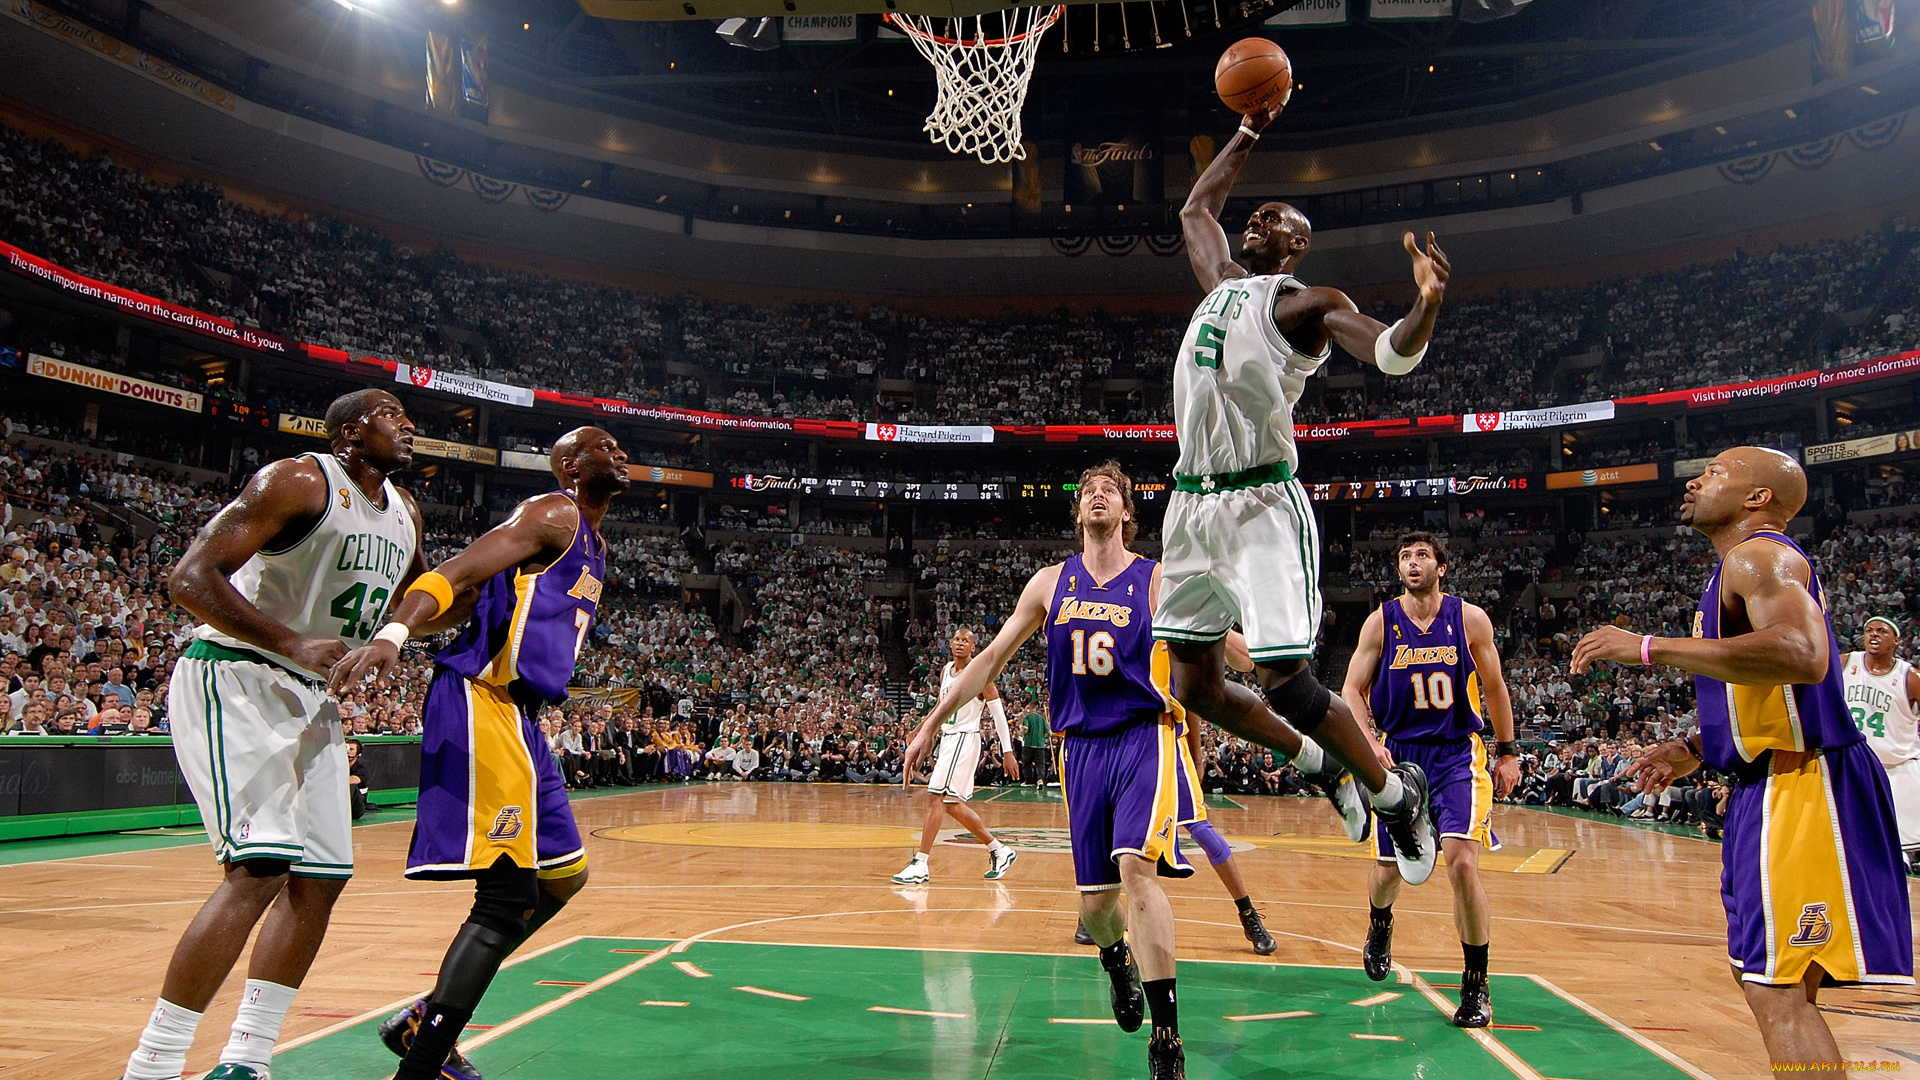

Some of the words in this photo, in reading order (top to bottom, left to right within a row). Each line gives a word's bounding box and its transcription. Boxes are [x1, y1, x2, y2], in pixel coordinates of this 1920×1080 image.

[788, 15, 852, 28] CHAMPIONS
[1099, 141, 1153, 161] Finals
[9, 252, 28, 270] The
[28, 262, 51, 281] most
[52, 270, 102, 299] important
[103, 291, 135, 308] name
[136, 302, 151, 314] on
[152, 304, 170, 319] the
[171, 310, 194, 326] card
[195, 313, 215, 333] isn't
[216, 323, 240, 339] ours.
[243, 330, 257, 344] It's
[257, 336, 285, 352] yours.
[1195, 322, 1227, 371] 5
[45, 364, 119, 393] DUNKIN'
[120, 379, 183, 408] DONUTS
[434, 371, 476, 391] Harvard
[475, 382, 510, 401] Pilgrim
[1692, 391, 1716, 403] Visit
[1717, 376, 1818, 400] harvardpilgrim.org
[1819, 372, 1835, 383] for
[1836, 367, 1866, 380] more
[601, 402, 621, 413] Visit
[621, 405, 701, 425] harvardpilgrim.org
[702, 414, 715, 425] for
[715, 417, 739, 428] more
[740, 418, 792, 431] information.
[1503, 411, 1548, 422] Harvard
[1549, 410, 1588, 424] Pilgrim
[899, 427, 937, 439] Harvard
[938, 430, 971, 443] Pilgrim
[1102, 427, 1123, 439] You
[1125, 427, 1153, 439] don't
[1155, 430, 1174, 438] see
[1311, 426, 1350, 438] doctor.
[1807, 443, 1846, 456] SPORTS
[1834, 449, 1860, 460] DESK
[730, 477, 745, 488] 15
[763, 475, 797, 491] Finals
[906, 483, 921, 491] 3PT
[1400, 479, 1416, 487] AST
[1427, 478, 1444, 486] REB
[1468, 476, 1507, 491] Finals
[1511, 478, 1528, 489] 15
[1143, 491, 1154, 500] 10
[1352, 491, 1357, 499] 1
[1378, 490, 1384, 498] 2
[1405, 488, 1411, 497] 4
[1431, 487, 1438, 496] 2
[337, 533, 405, 586] CELTICS
[330, 581, 390, 641] 43
[1054, 596, 1132, 628] LAKERS
[574, 607, 591, 661] 7
[1071, 629, 1115, 676] 16
[1389, 644, 1458, 669] LAKERS
[1410, 671, 1454, 710] 10
[1847, 684, 1892, 712] CELTICS
[1850, 707, 1885, 738] 34
[116, 769, 138, 784] abc
[141, 767, 174, 786] Home
